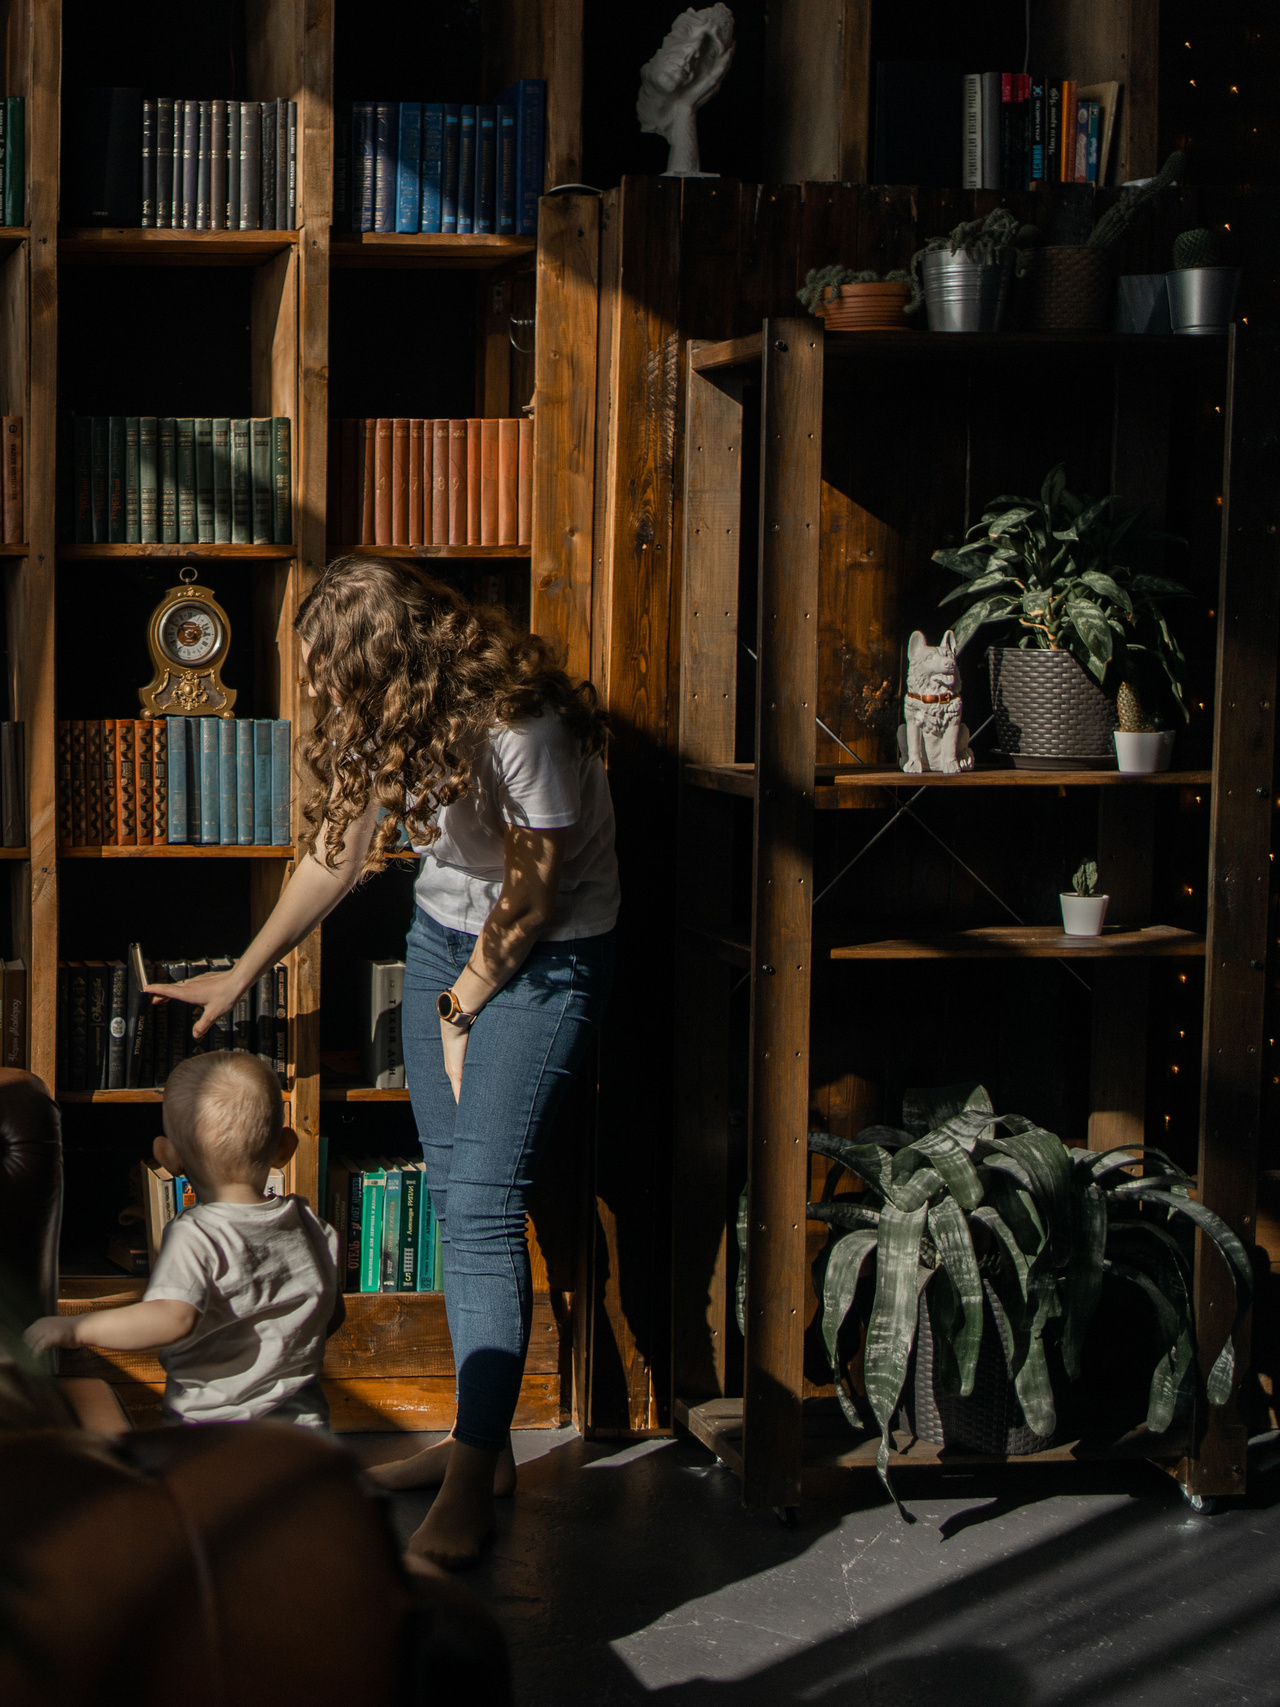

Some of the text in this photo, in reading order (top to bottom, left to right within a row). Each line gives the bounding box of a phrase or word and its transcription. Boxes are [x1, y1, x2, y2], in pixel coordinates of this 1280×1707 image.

[379, 477, 386, 489] 4
[437, 476, 445, 491] 8
[452, 477, 460, 491] 9
[387, 998, 397, 1075] ТИХИЙ ДОН
[407, 1185, 415, 1208] РИПЛИ
[347, 1240, 361, 1270] ОТЕЛЬ
